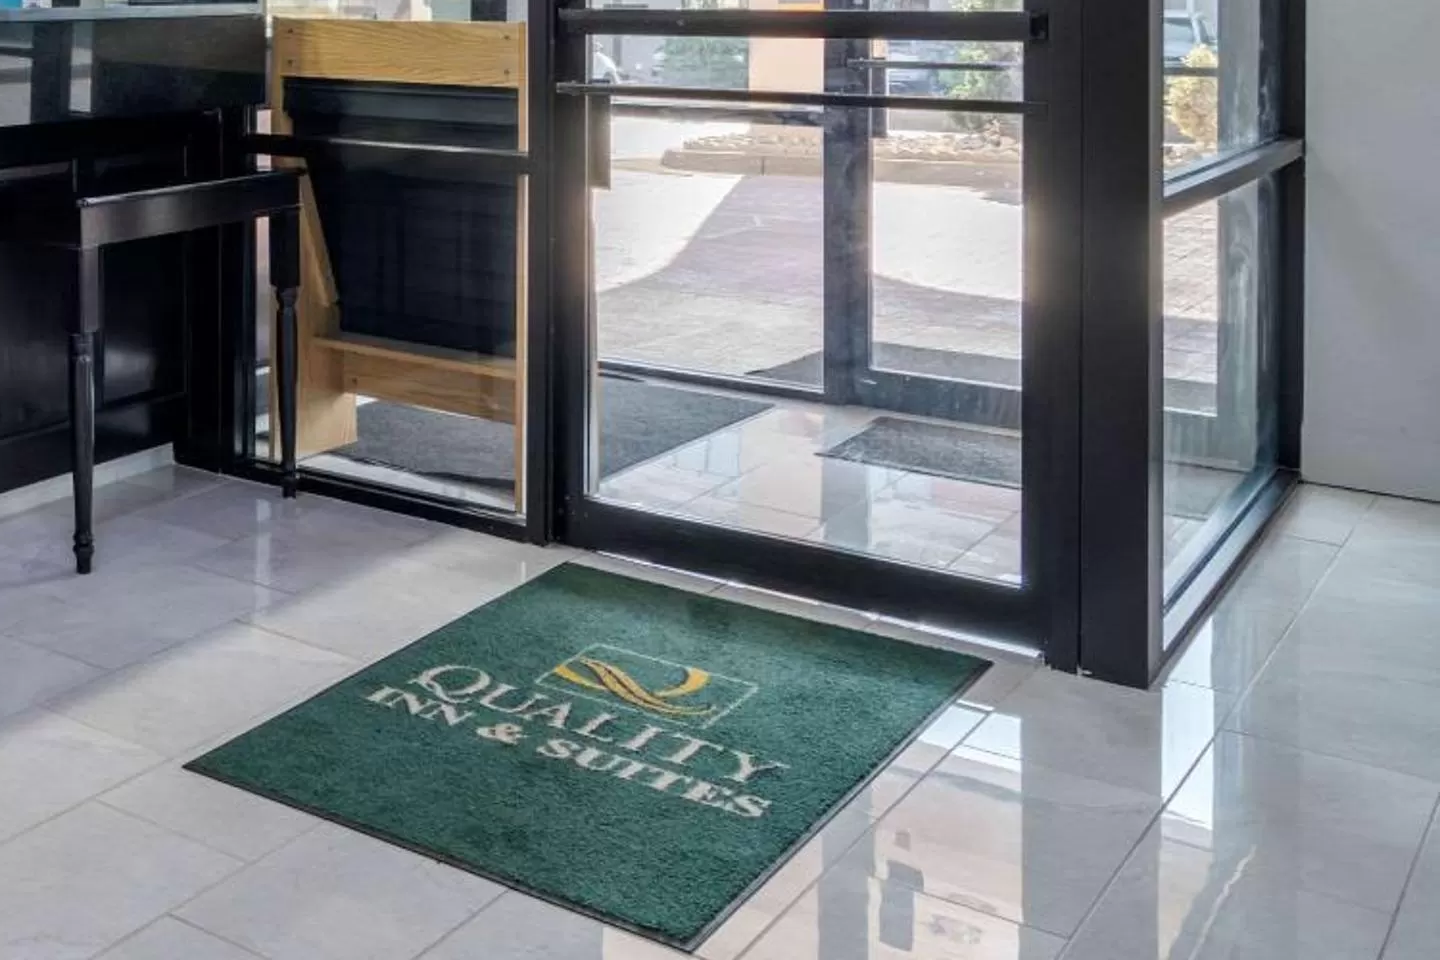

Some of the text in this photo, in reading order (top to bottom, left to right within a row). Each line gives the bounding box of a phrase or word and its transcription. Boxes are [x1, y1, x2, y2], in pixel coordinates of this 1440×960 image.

[365, 686, 771, 818] INN & SUITES
[410, 664, 790, 783] QUALITY
